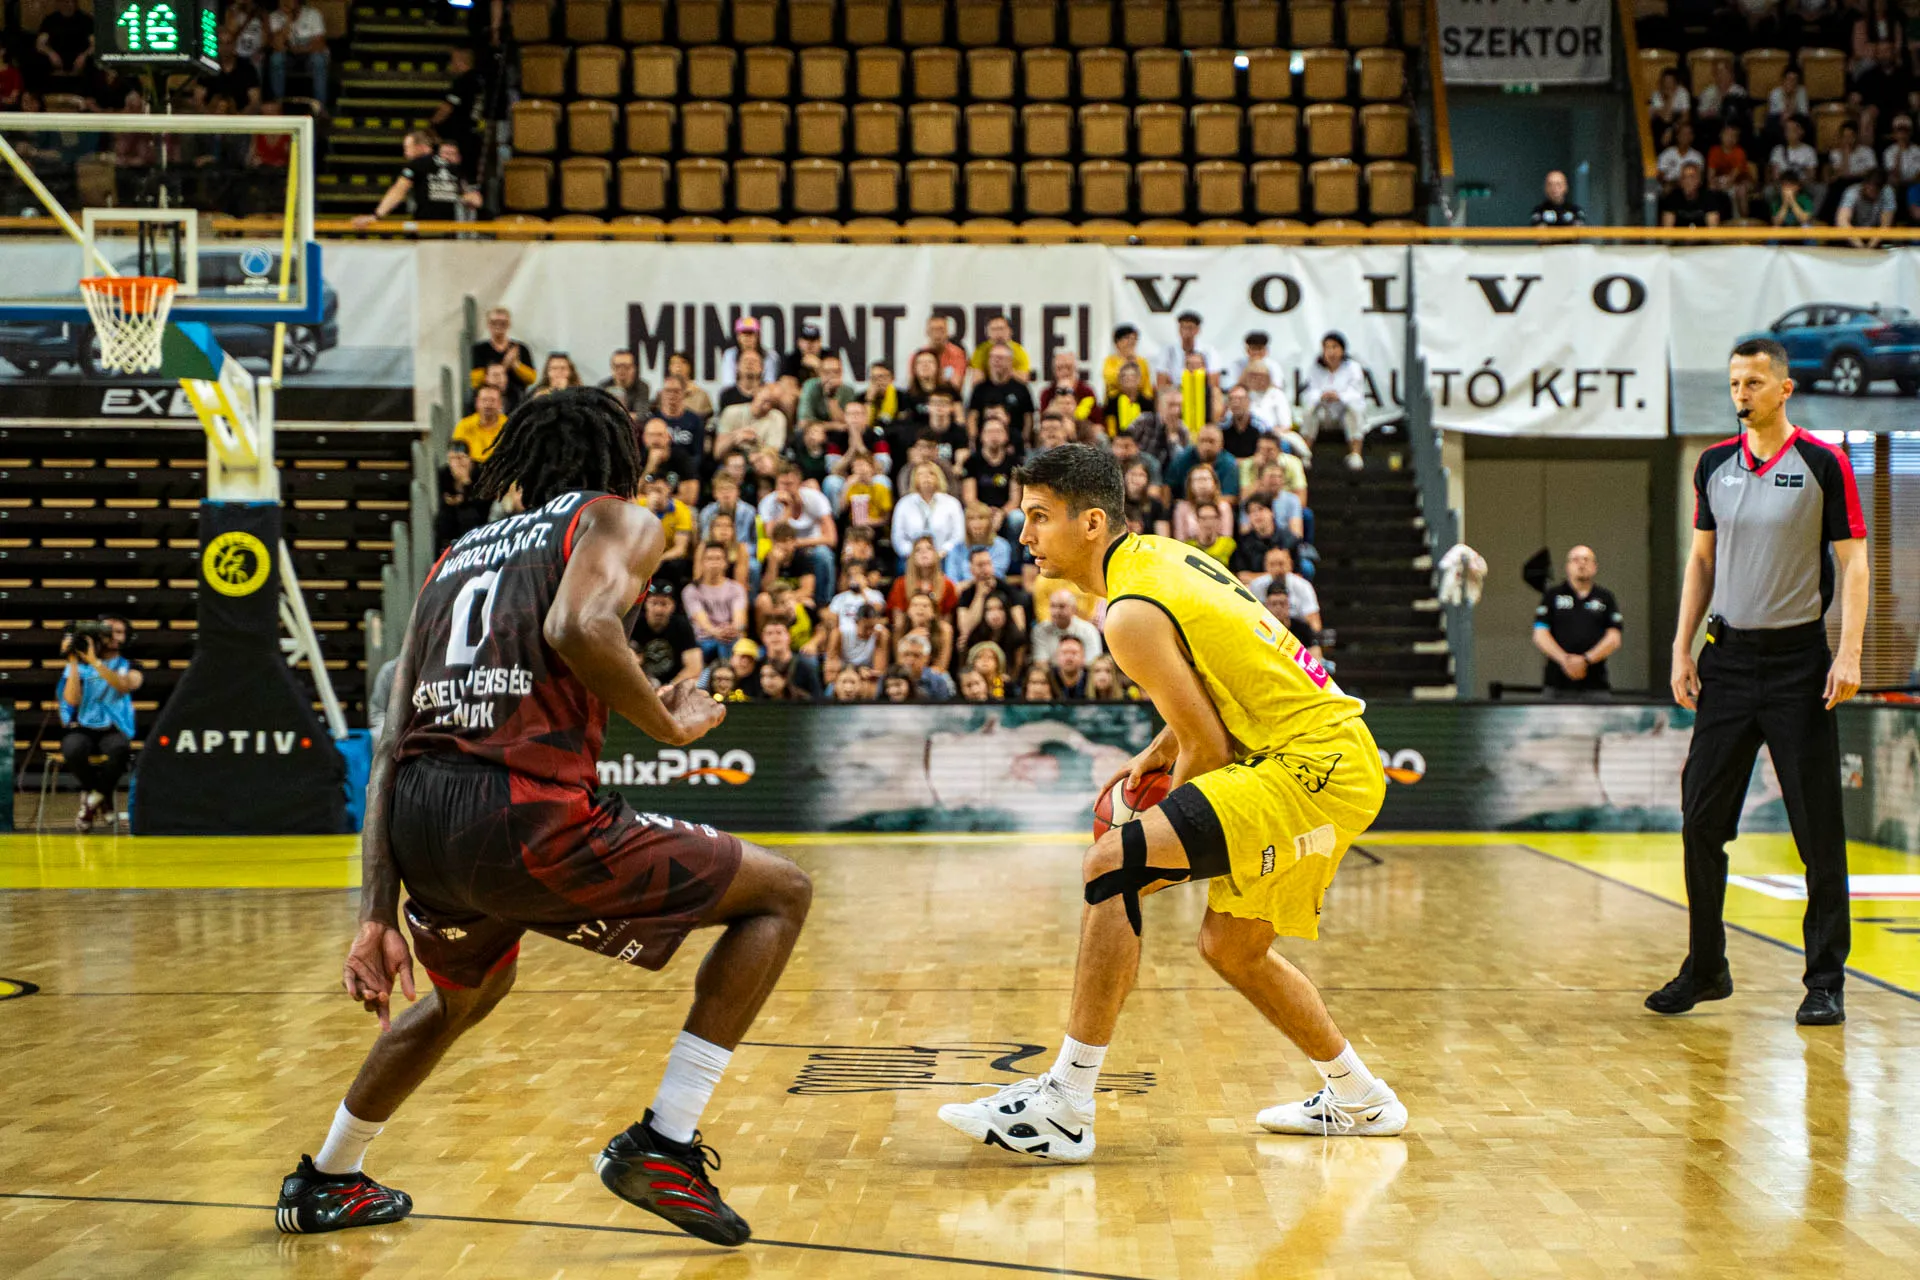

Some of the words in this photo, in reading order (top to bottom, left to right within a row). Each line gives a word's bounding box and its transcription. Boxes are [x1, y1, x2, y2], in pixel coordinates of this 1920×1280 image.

[116, 4, 178, 51] 16
[1443, 26, 1603, 57] SZEKTOR
[1532, 368, 1647, 409] KFT.
[445, 570, 503, 667] 0
[175, 730, 297, 754] APTIV
